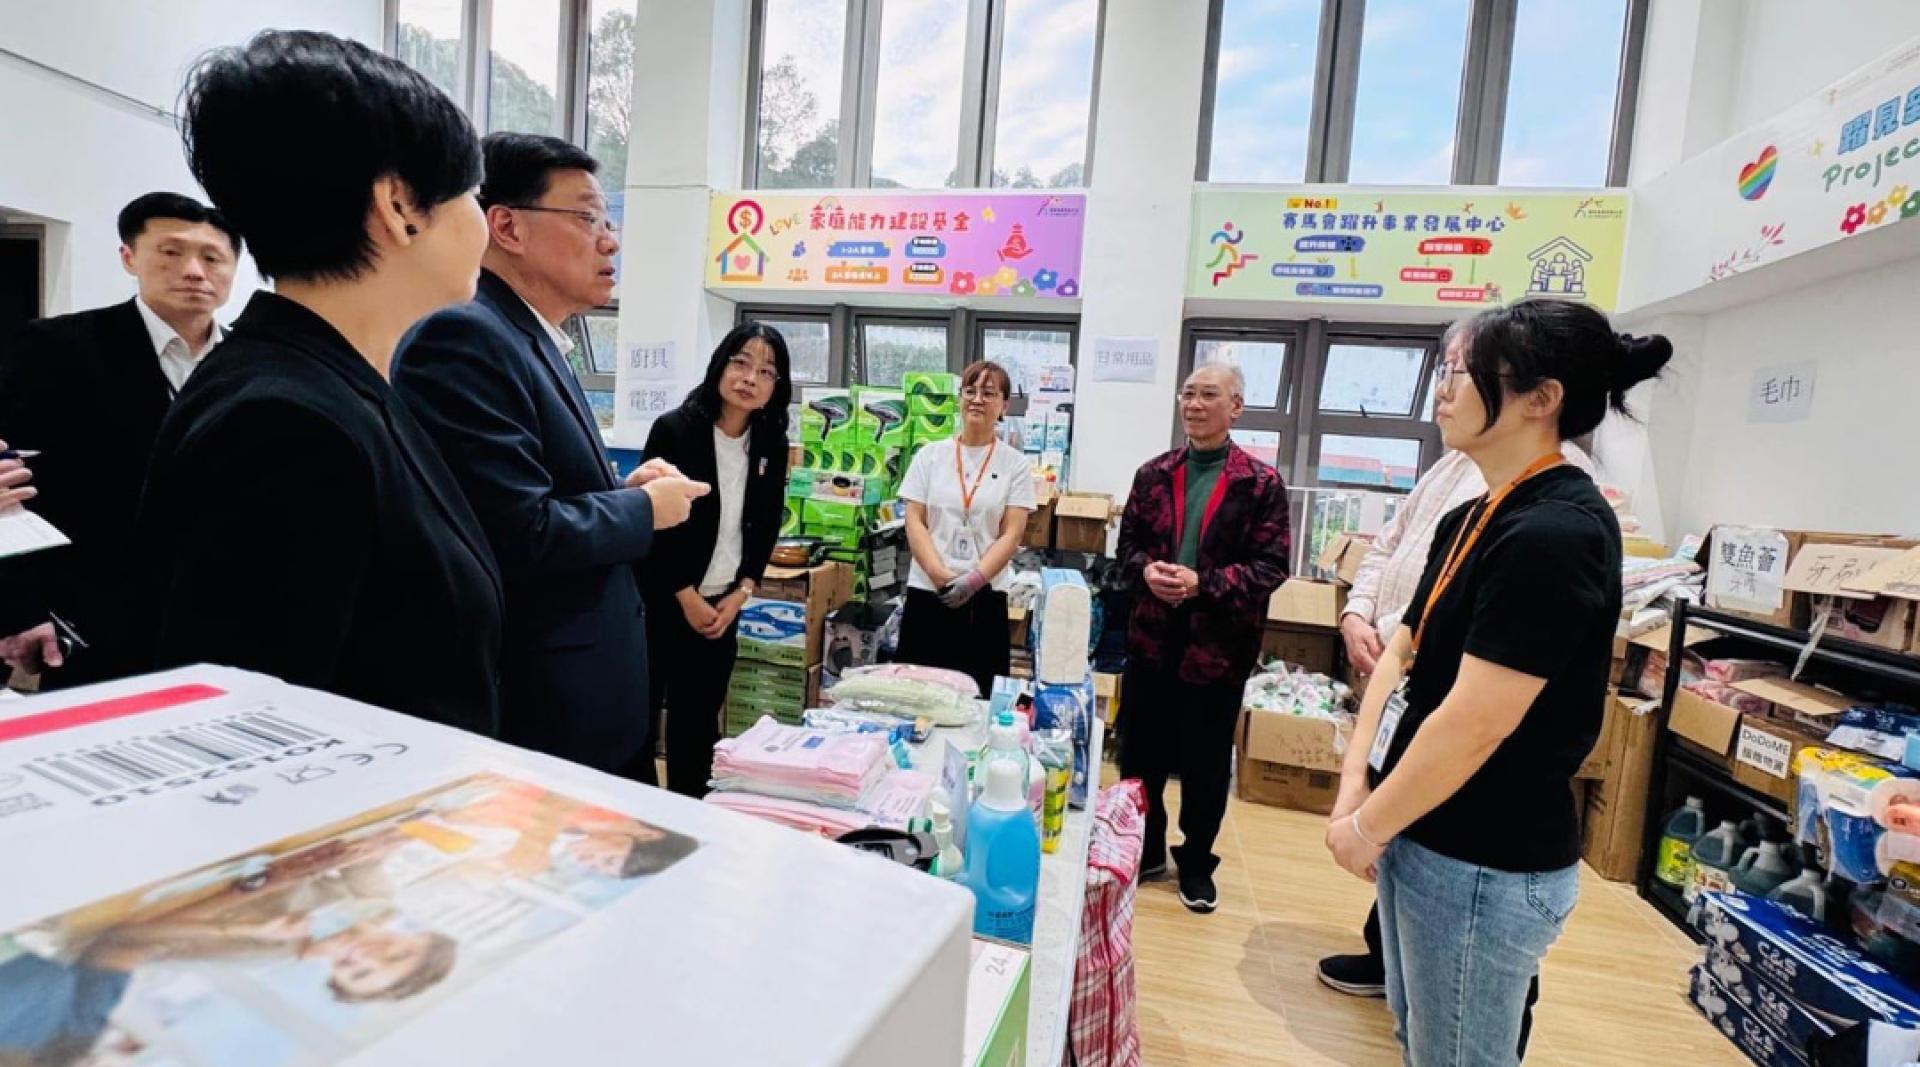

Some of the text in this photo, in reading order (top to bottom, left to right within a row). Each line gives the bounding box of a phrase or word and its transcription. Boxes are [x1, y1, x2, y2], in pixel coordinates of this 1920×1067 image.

[808, 204, 971, 231] 家庭能力建設基金
[1282, 211, 1505, 232] 賽馬會躍升事業發展中心
[1097, 351, 1153, 368] 日常用品
[629, 389, 667, 412] 電器
[1759, 375, 1801, 405] 毛巾
